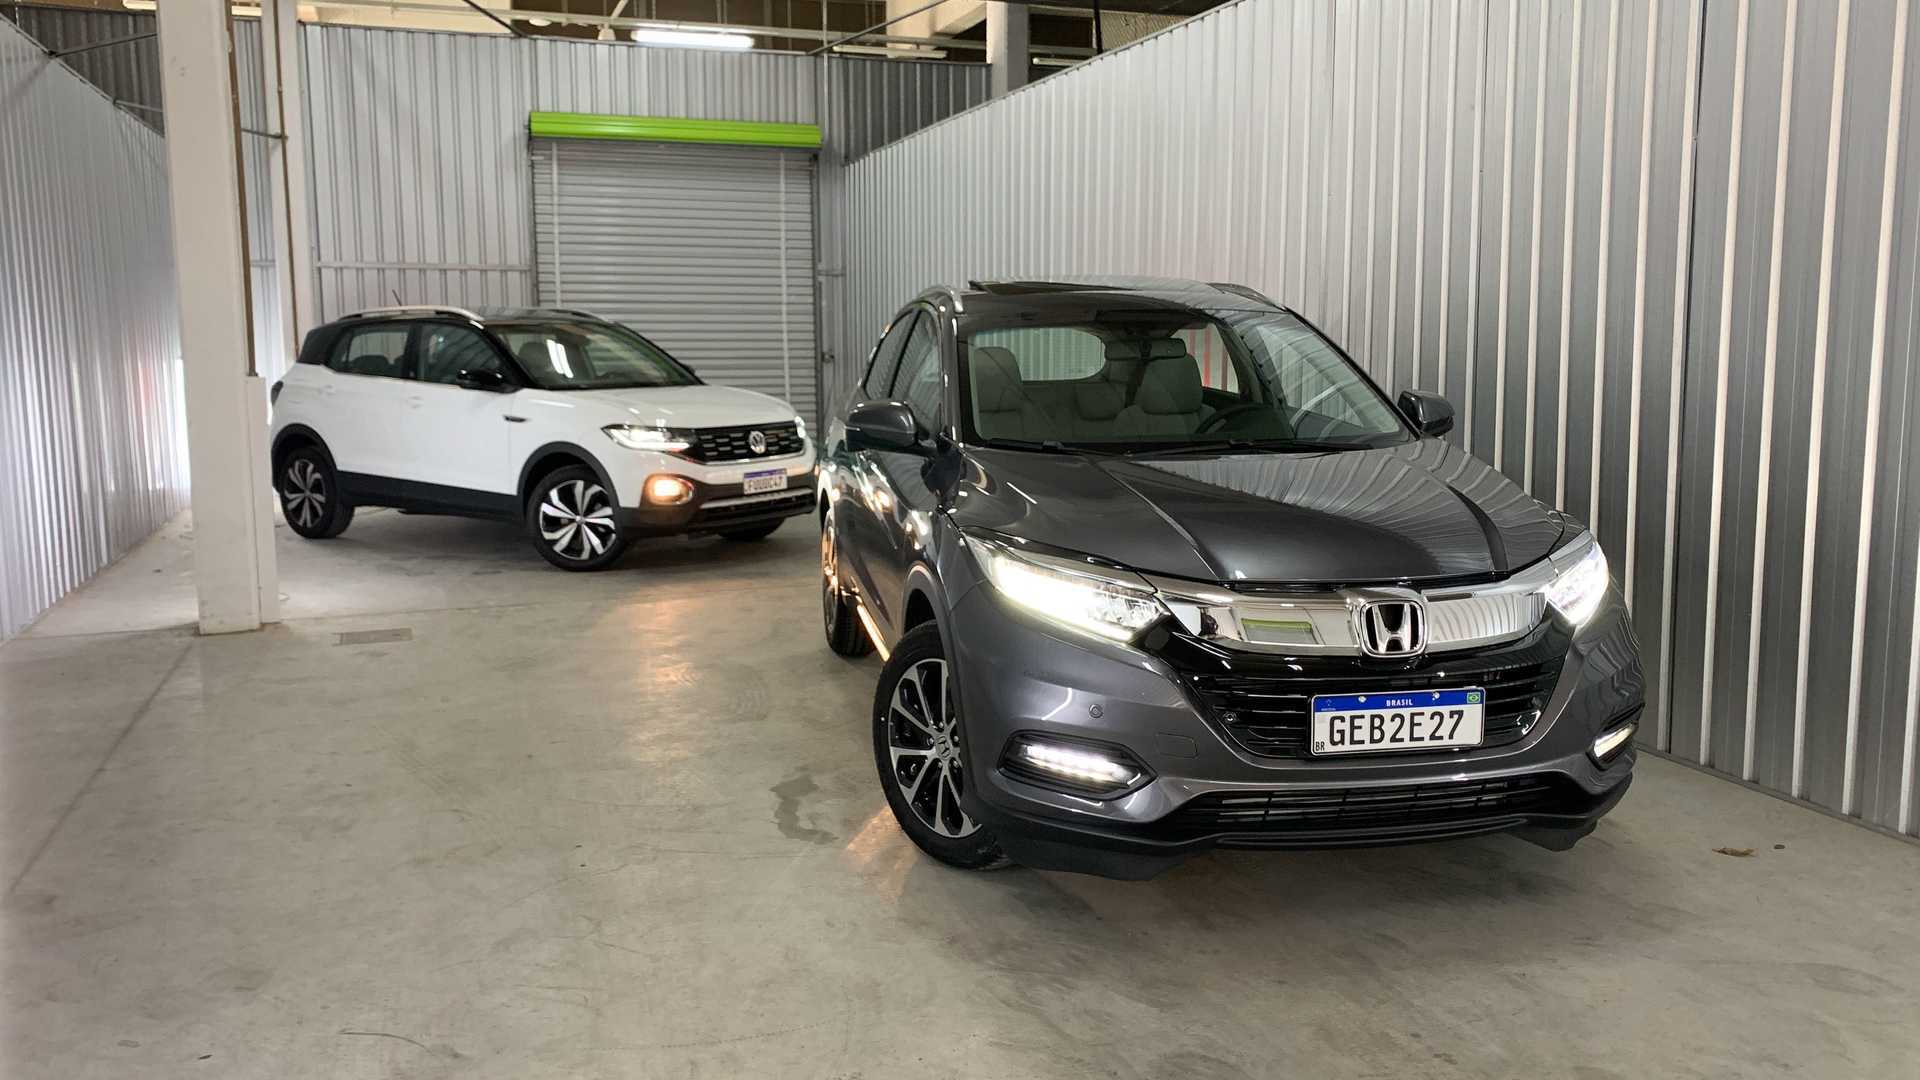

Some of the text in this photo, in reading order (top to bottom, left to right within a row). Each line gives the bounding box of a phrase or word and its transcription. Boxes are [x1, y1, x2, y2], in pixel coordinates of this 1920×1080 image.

[1386, 699, 1413, 707] BRASIL
[1329, 709, 1464, 747] GEB2E27
[1315, 741, 1325, 752] BR
